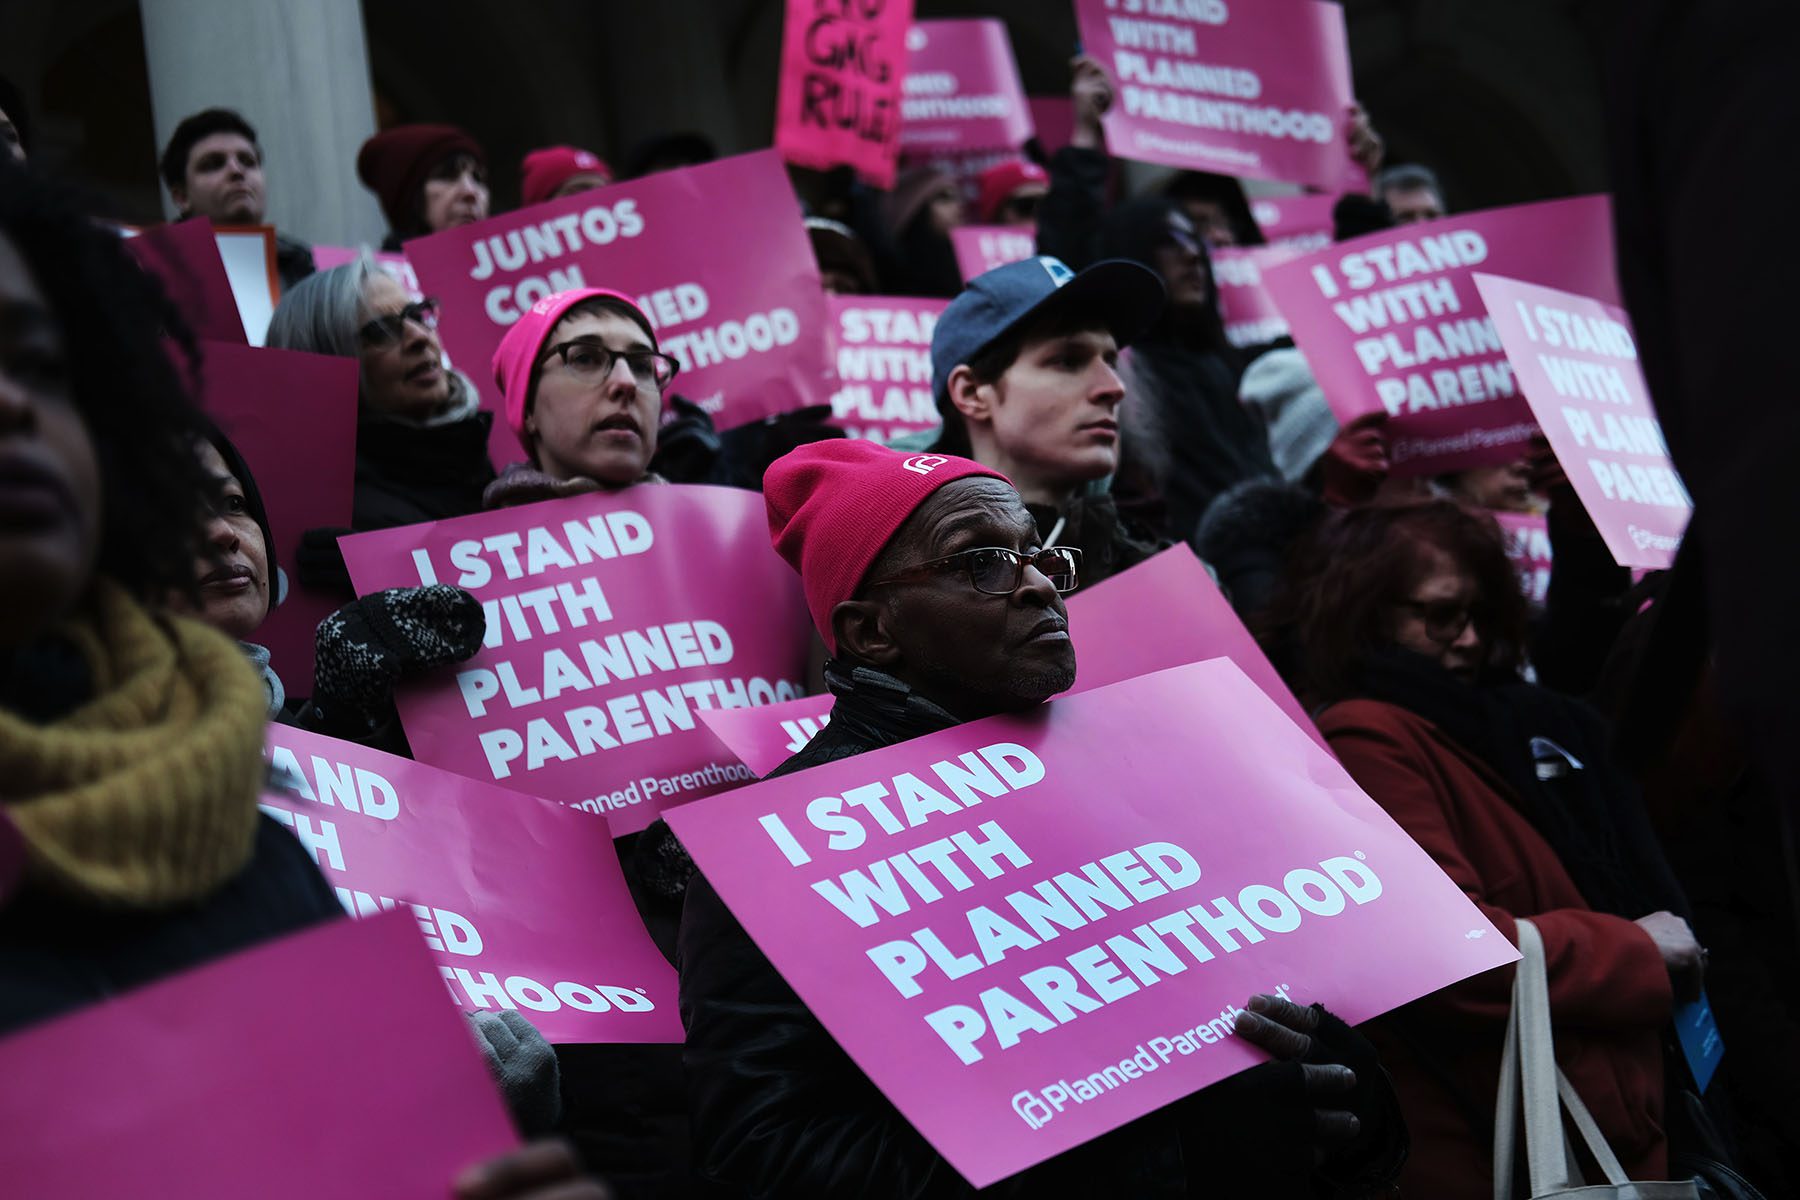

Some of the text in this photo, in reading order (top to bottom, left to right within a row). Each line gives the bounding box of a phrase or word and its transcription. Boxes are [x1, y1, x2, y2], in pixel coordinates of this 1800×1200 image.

[1109, 16, 1197, 56] WITH
[1114, 49, 1261, 99] PLANNED
[1121, 84, 1333, 143] PARENTHOOD
[470, 198, 645, 281] JUNTOS
[1312, 264, 1338, 299] I
[1339, 229, 1490, 290] STAND
[484, 264, 588, 326] CON
[1333, 276, 1461, 334] WITH
[659, 306, 800, 374] THOOD
[1353, 315, 1505, 376] PLANN
[1515, 299, 1638, 361] I STAND
[829, 384, 941, 423] PLAN
[1375, 359, 1522, 417] PAREN
[1537, 353, 1632, 405] WITH
[411, 510, 654, 589] I STAND
[456, 620, 734, 719] PLANNED
[478, 676, 804, 780] PARENTHO
[272, 745, 400, 821] AND
[563, 781, 641, 815] nned
[758, 742, 1046, 868] I STAND
[810, 820, 1033, 929] WITH
[865, 842, 1202, 999] PLANNED
[1040, 1044, 1160, 1113] Planned
